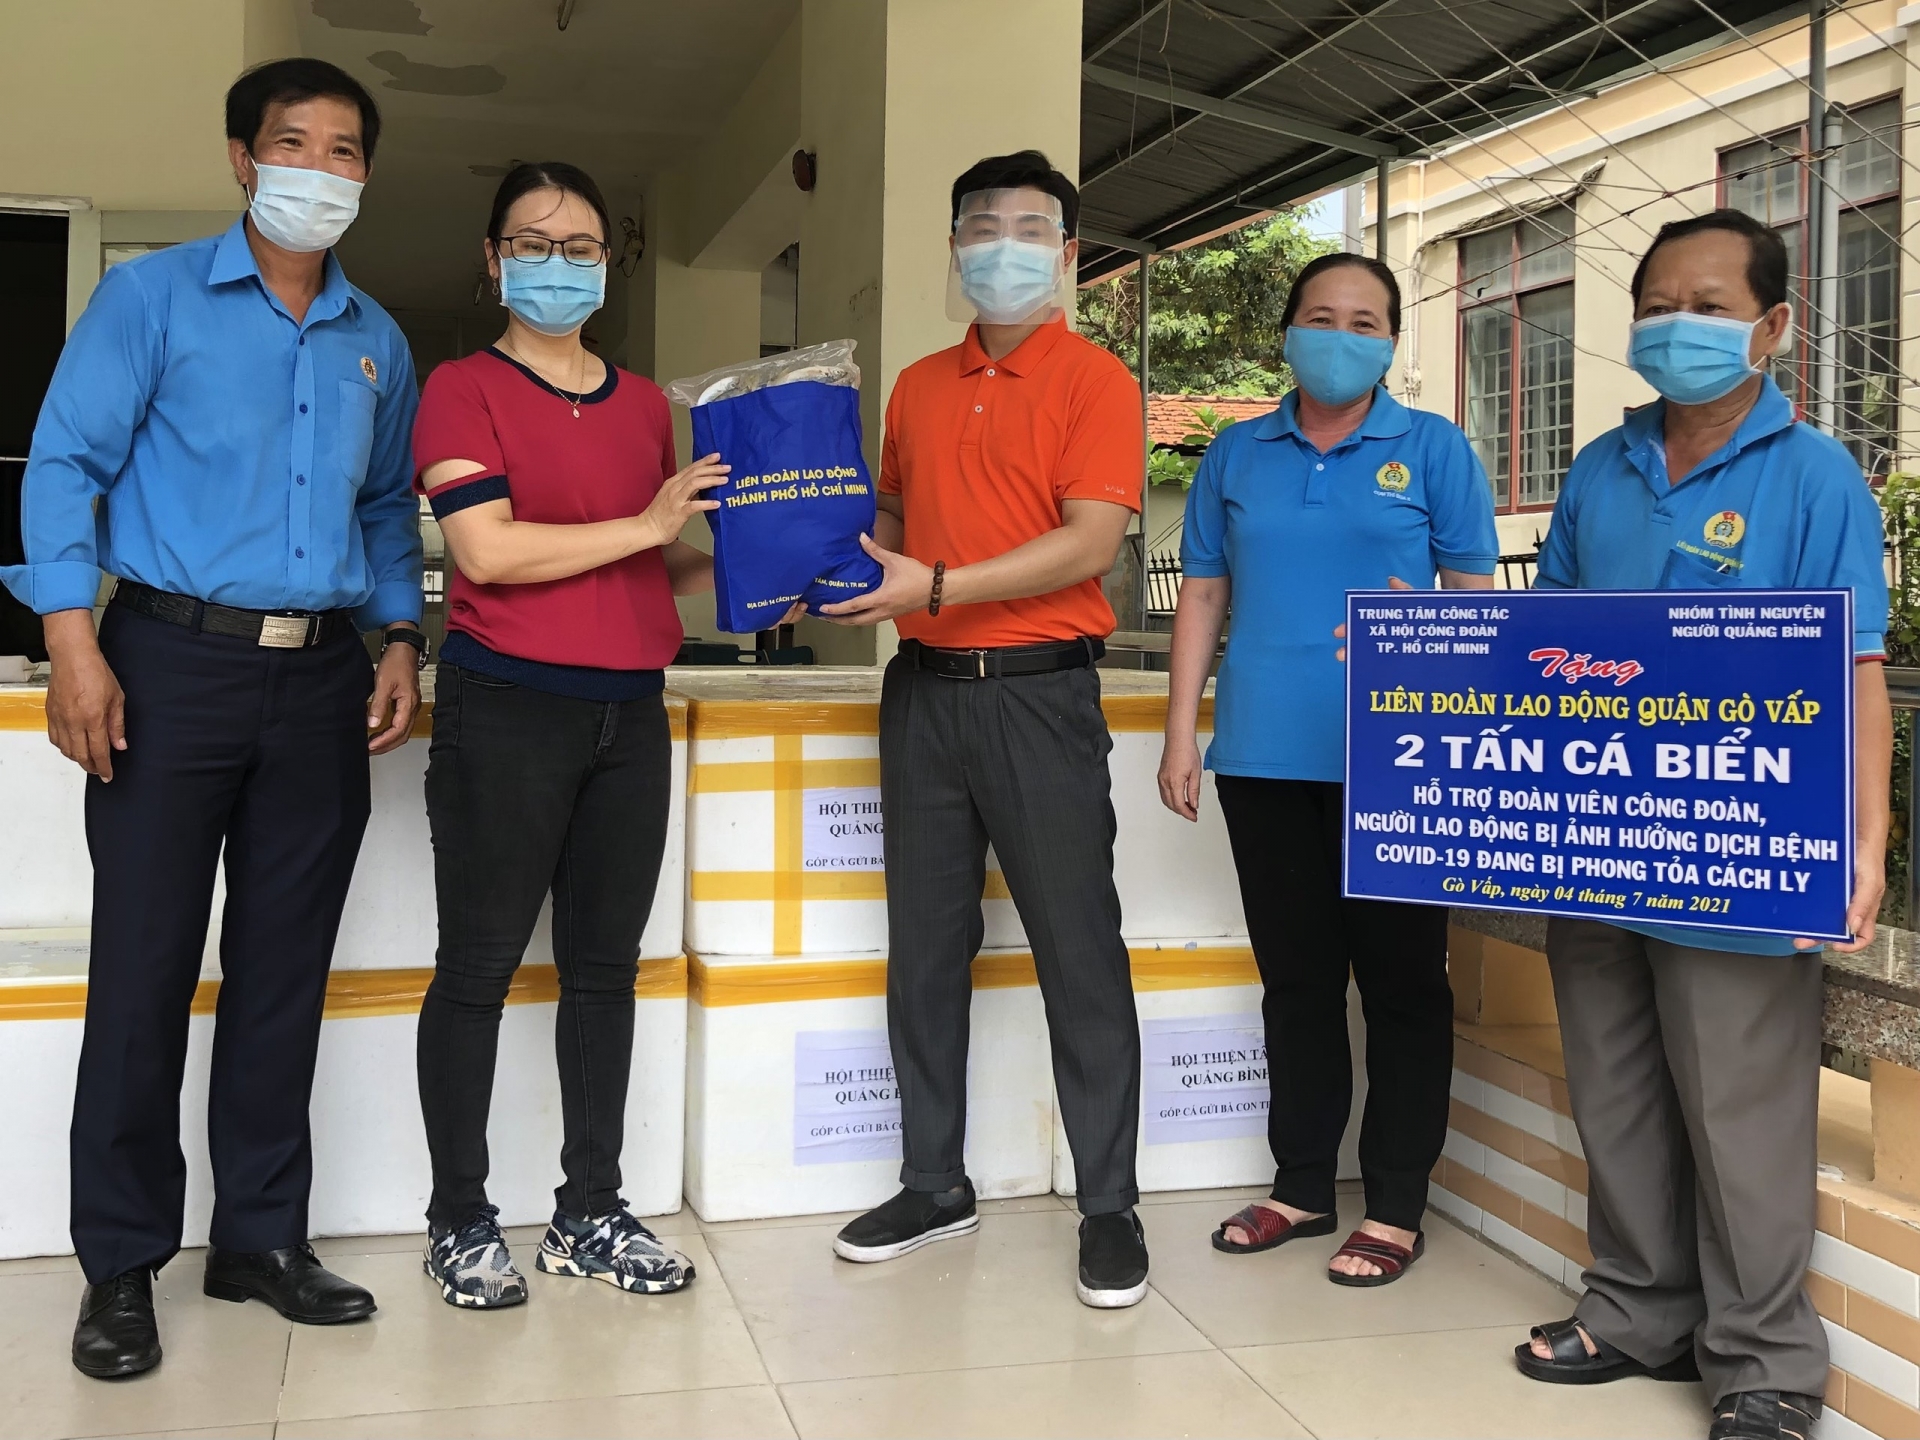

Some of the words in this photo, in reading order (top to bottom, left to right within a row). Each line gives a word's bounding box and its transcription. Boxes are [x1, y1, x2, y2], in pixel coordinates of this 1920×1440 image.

[736, 476, 759, 489] LIÊN
[762, 469, 800, 484] ĐOÀN
[802, 469, 824, 479] LAO
[826, 466, 857, 480] ĐỘNG
[726, 491, 767, 508] THÀNH
[771, 484, 798, 501] PHỐ
[801, 482, 819, 498] HỒ
[822, 482, 842, 496] CHÍ
[844, 484, 868, 495] MINH
[776, 596, 790, 604] CÁCH
[829, 580, 845, 589] QUẬN
[1357, 608, 1403, 620] TRUNG
[1406, 605, 1437, 620] TÂM
[1440, 605, 1478, 620] CÔNG
[1480, 605, 1510, 620] TÁC
[1669, 605, 1713, 619] NHÓM
[1718, 605, 1755, 619] TÌNH
[1760, 604, 1826, 622] NGUYỆN
[1370, 624, 1386, 636] XÃ
[1391, 624, 1414, 638] HỘI
[1418, 624, 1455, 636] CÔNG
[1459, 624, 1497, 636] ĐOÀN
[1673, 624, 1719, 637] NGƯỜI
[1724, 622, 1777, 639] QUẢNG
[1782, 624, 1821, 637] BÌNH
[1377, 643, 1398, 653] TP.
[1403, 639, 1421, 653] HỒ
[1425, 640, 1449, 653] CHÍ
[1453, 643, 1489, 654] MINH
[1529, 648, 1644, 686] Tặng
[1370, 685, 1424, 712] LIÊN
[1431, 687, 1497, 714] ĐOÀN
[1504, 694, 1551, 716] LAO
[1559, 690, 1630, 723] ĐỘNG
[1638, 692, 1710, 726] QUẬN
[1719, 693, 1755, 722] GÒ
[1764, 689, 1820, 723] VẤP
[1395, 735, 1424, 767] 2
[1441, 725, 1543, 772] TẤN
[1563, 733, 1632, 776] CÁ
[1656, 727, 1790, 783] BIỂN
[819, 801, 847, 818] HỘI
[1414, 778, 1442, 805] HỖ
[1449, 787, 1493, 811] TRỢ
[1499, 787, 1558, 811] ĐOÀN
[1566, 790, 1617, 814] VIÊN
[1625, 792, 1686, 819] CÔNG
[1694, 796, 1766, 827] ĐOÀN,
[829, 820, 884, 838] QUẢNG
[1355, 810, 1415, 833] NGƯỜI
[1423, 816, 1462, 836] LAO
[1469, 815, 1528, 843] ĐỘNG
[1536, 823, 1557, 847] BỊ
[1564, 818, 1610, 846] ẢNH
[1619, 822, 1697, 852] HƯỞNG
[1705, 833, 1760, 858] DỊCH
[1770, 833, 1837, 862] BỆNH
[805, 857, 828, 867] GÓP
[830, 856, 845, 866] CÁ
[847, 855, 868, 866] GỬI
[1376, 844, 1470, 867] COVID-19
[1477, 850, 1534, 872] ĐANG
[1542, 855, 1563, 879] BỊ
[1572, 857, 1646, 881] PHONG
[1653, 856, 1699, 884] TỎA
[1707, 862, 1770, 889] CÁCH
[1780, 871, 1810, 892] LY
[1443, 877, 1465, 892] Gò
[1472, 876, 1505, 898] Vấp,
[1510, 884, 1549, 902] ngày
[1554, 886, 1574, 900] 04
[1578, 888, 1626, 908] tháng
[1633, 892, 1642, 905] 7
[1646, 894, 1683, 909] năm
[1689, 896, 1730, 913] 2021
[1171, 1053, 1198, 1069] HỘI
[1202, 1049, 1247, 1065] THIỆN
[1250, 1045, 1267, 1061] TÂ
[825, 1068, 852, 1085] HỘI
[857, 1066, 895, 1082] THIỆ
[1182, 1070, 1234, 1088] QUẢNG
[1160, 1107, 1180, 1118] GÓP
[1183, 1105, 1197, 1116] CÁ
[1199, 1103, 1218, 1115] GỬI
[1236, 1102, 1257, 1112] CON
[810, 1125, 833, 1137] GÓP
[835, 1123, 850, 1135] CÁ
[853, 1121, 872, 1133] GỬI
